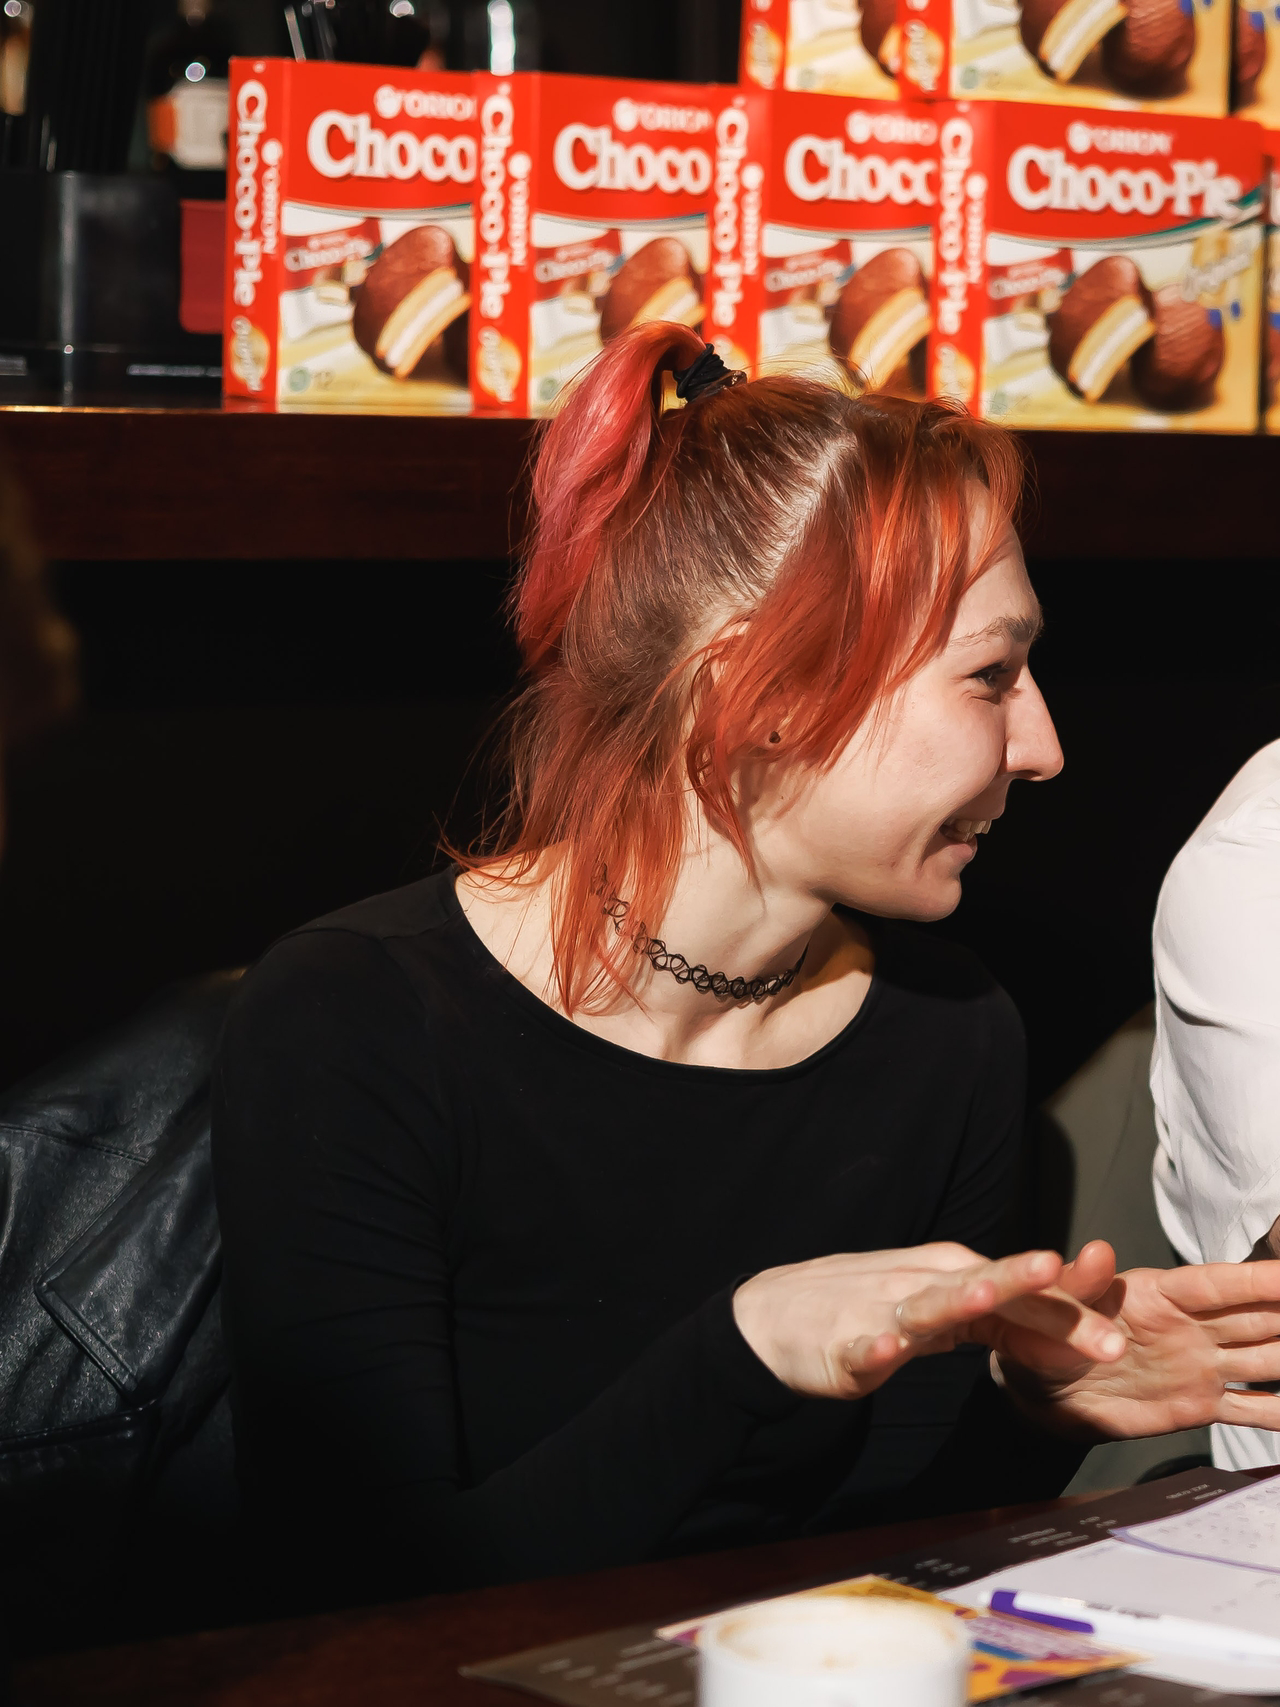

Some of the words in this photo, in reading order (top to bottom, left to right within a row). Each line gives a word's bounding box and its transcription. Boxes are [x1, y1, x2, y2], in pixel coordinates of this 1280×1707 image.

[307, 110, 477, 184] Choco
[553, 122, 712, 195] Choco
[1007, 144, 1245, 220] Choco-Pie
